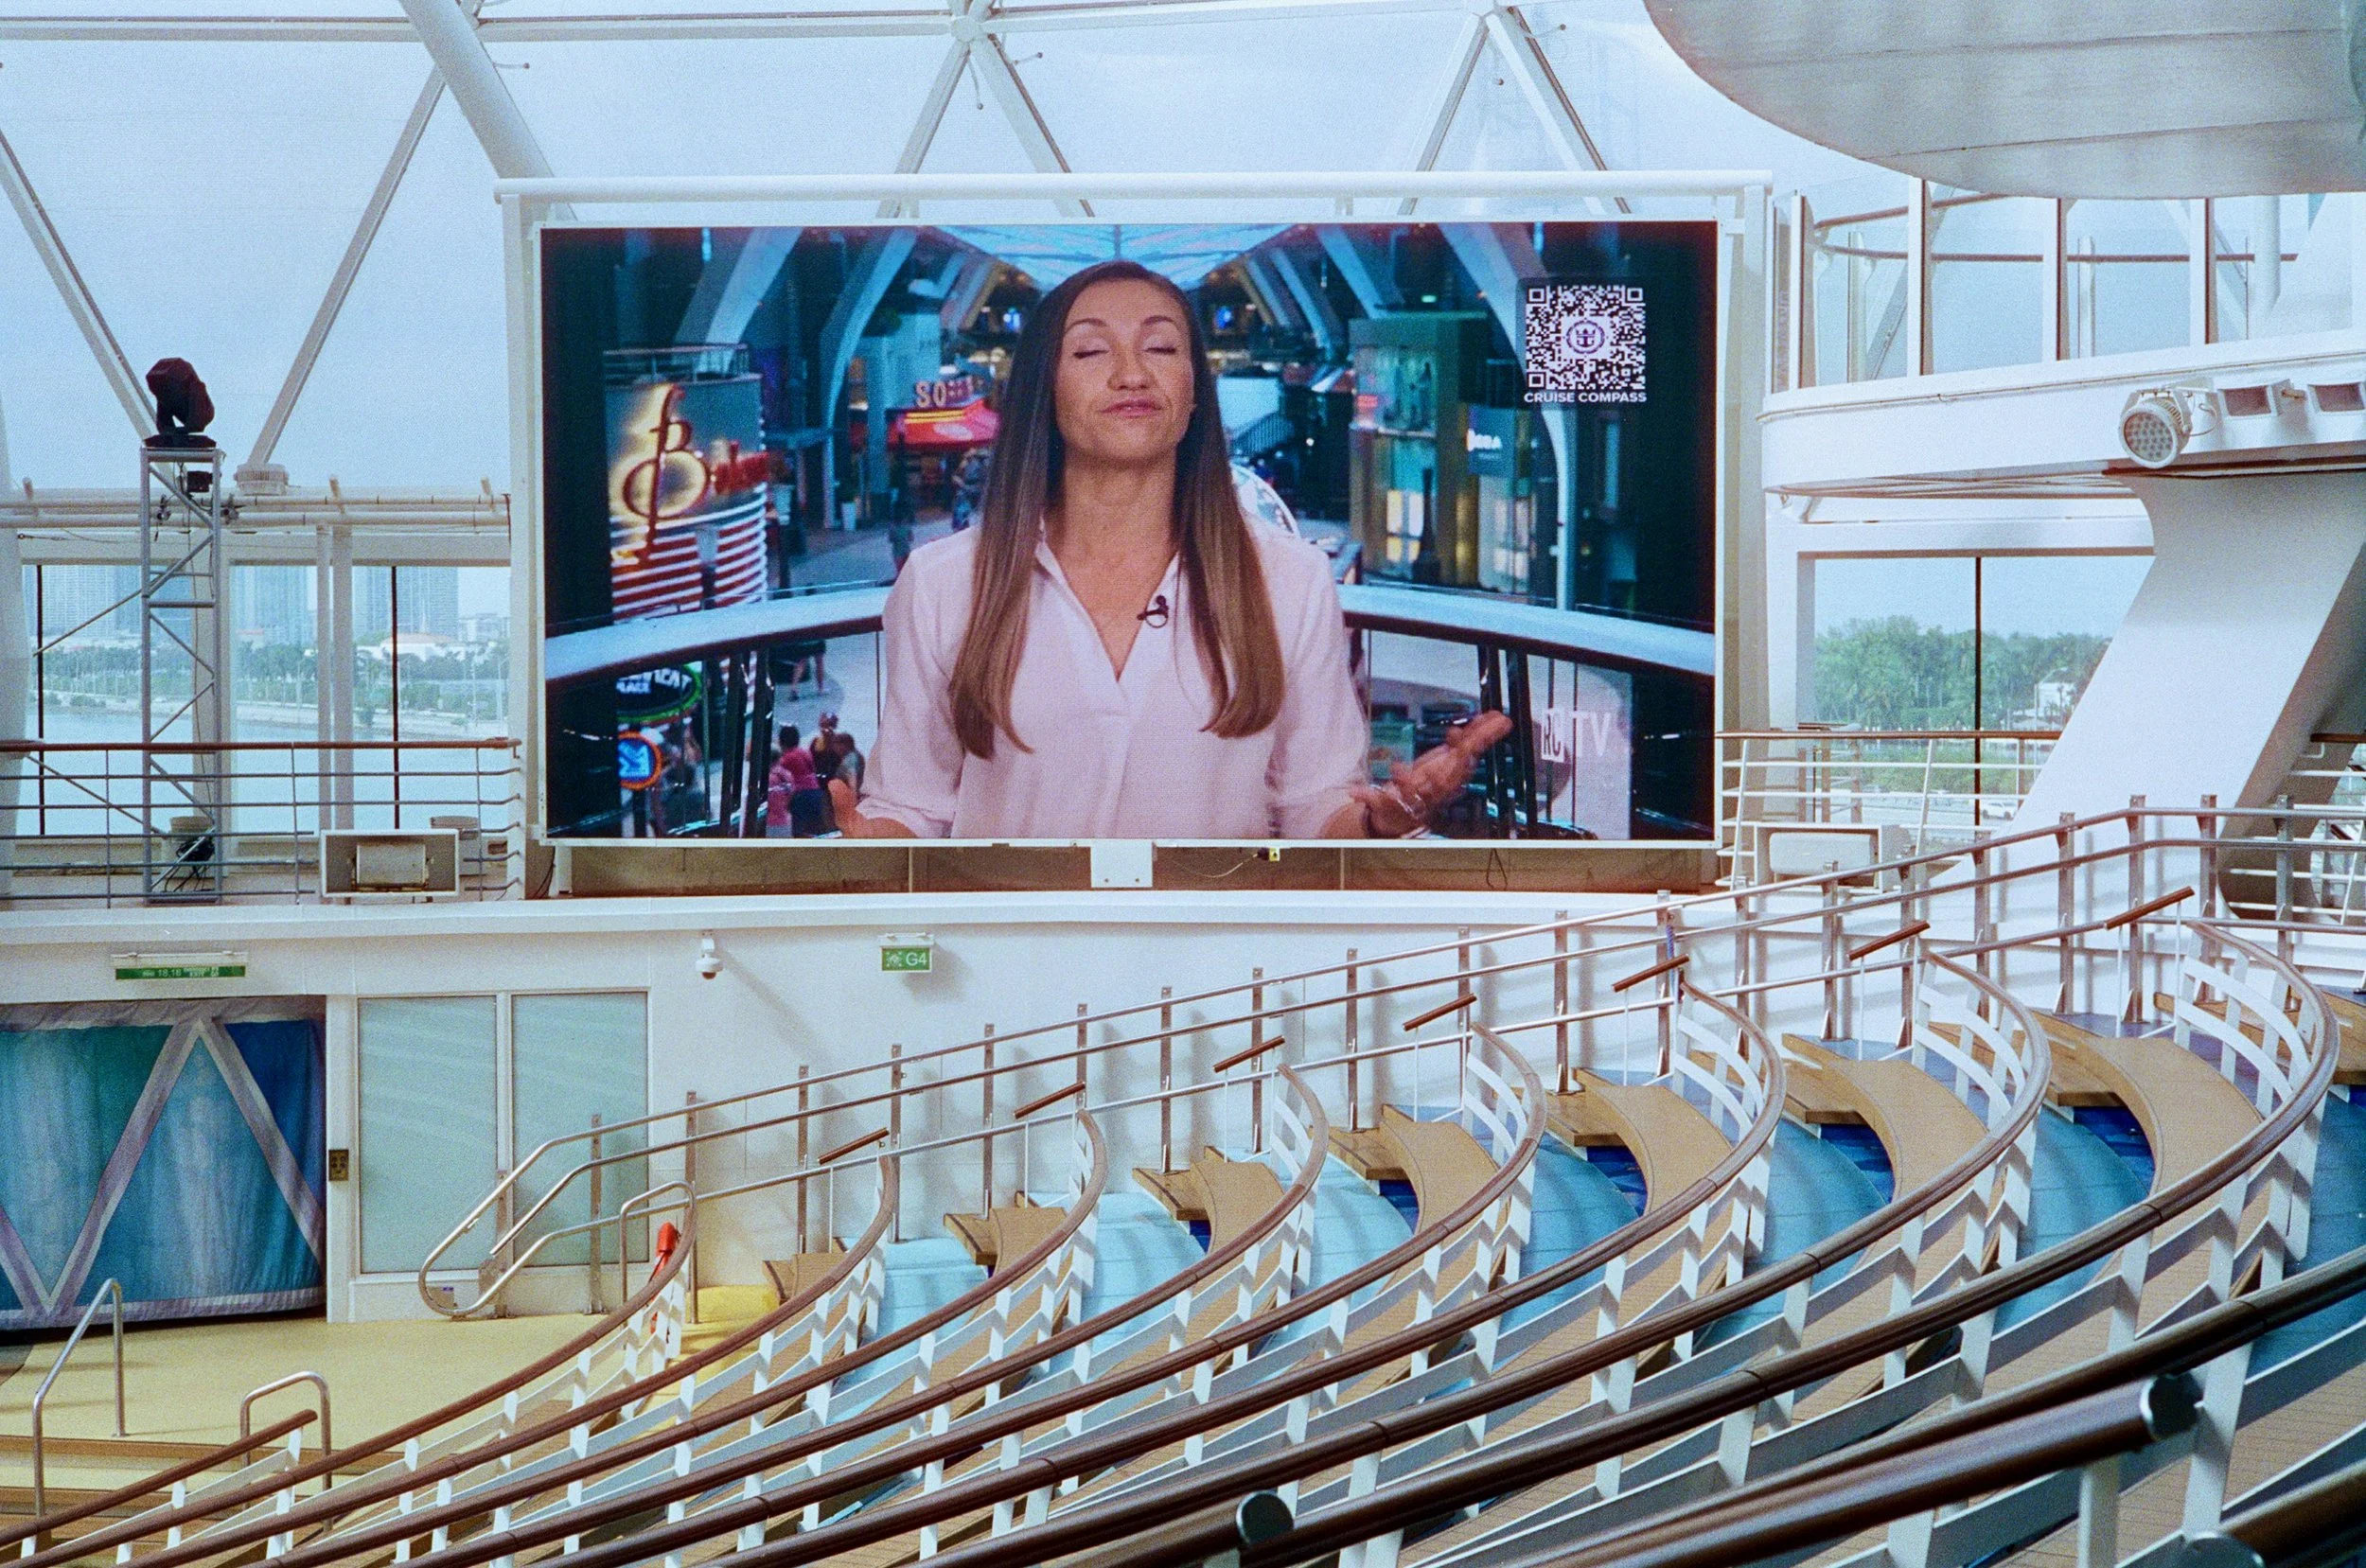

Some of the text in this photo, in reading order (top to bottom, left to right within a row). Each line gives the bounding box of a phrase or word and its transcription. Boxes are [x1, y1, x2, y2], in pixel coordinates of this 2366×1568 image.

[1524, 392, 1647, 403] CRUISE COMPASS
[906, 952, 927, 966] G4
